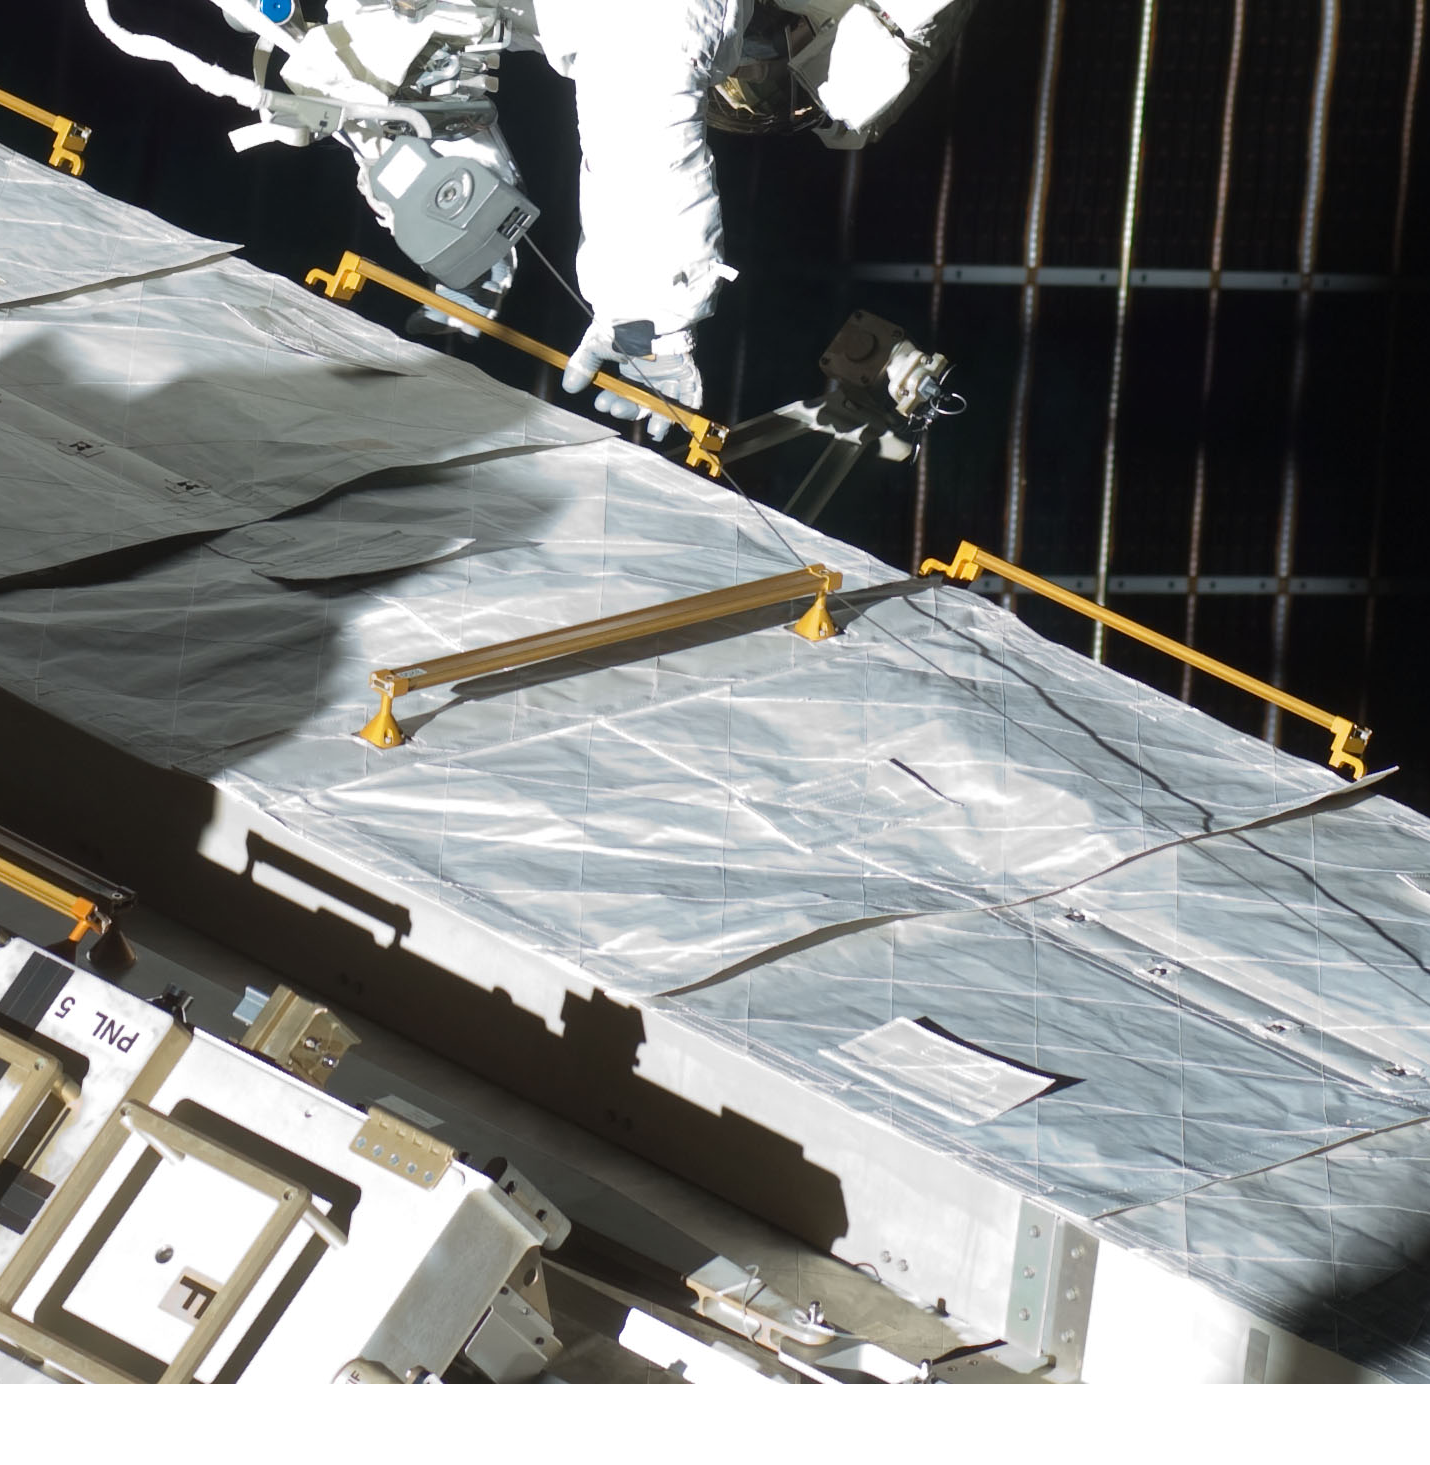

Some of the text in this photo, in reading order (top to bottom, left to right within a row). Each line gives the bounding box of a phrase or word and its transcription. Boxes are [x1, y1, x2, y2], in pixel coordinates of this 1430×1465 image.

[54, 996, 140, 1053] PNL 5
[179, 1274, 218, 1320] F
